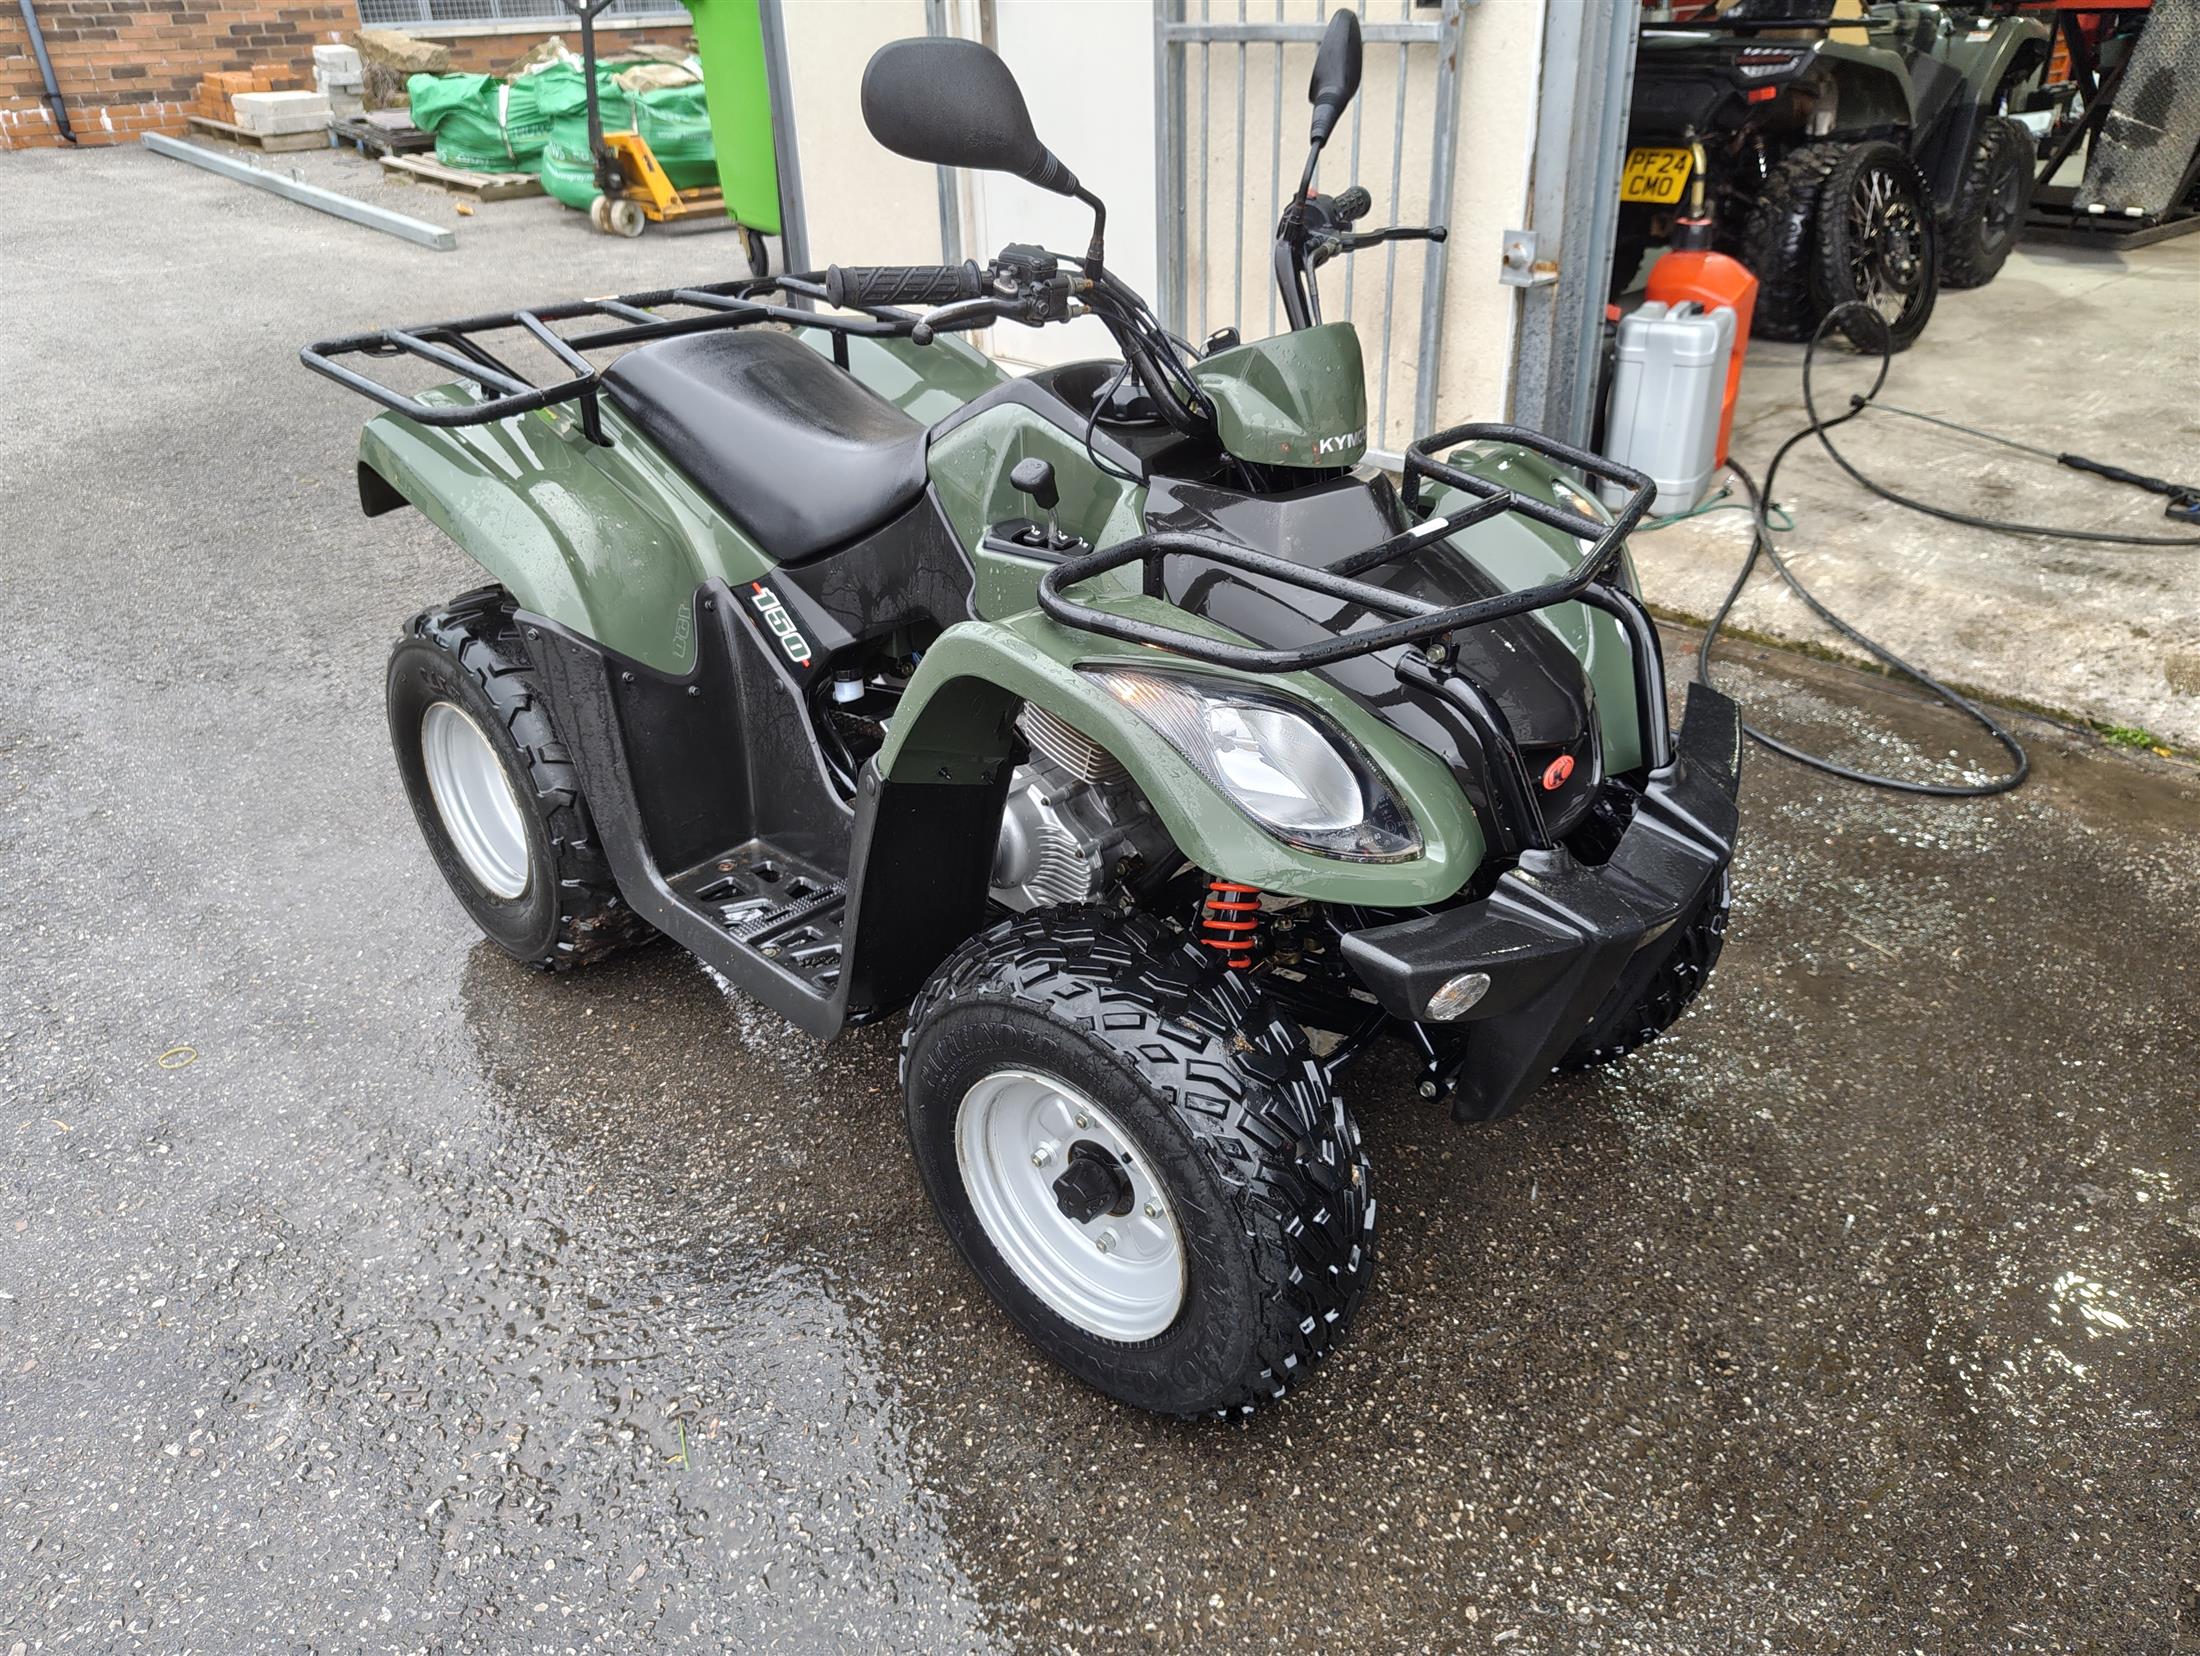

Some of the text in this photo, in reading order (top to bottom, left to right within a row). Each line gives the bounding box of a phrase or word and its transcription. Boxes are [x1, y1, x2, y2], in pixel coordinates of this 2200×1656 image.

[1629, 151, 1687, 174] PF24
[1628, 175, 1674, 197] CMO
[752, 586, 813, 663] 150
